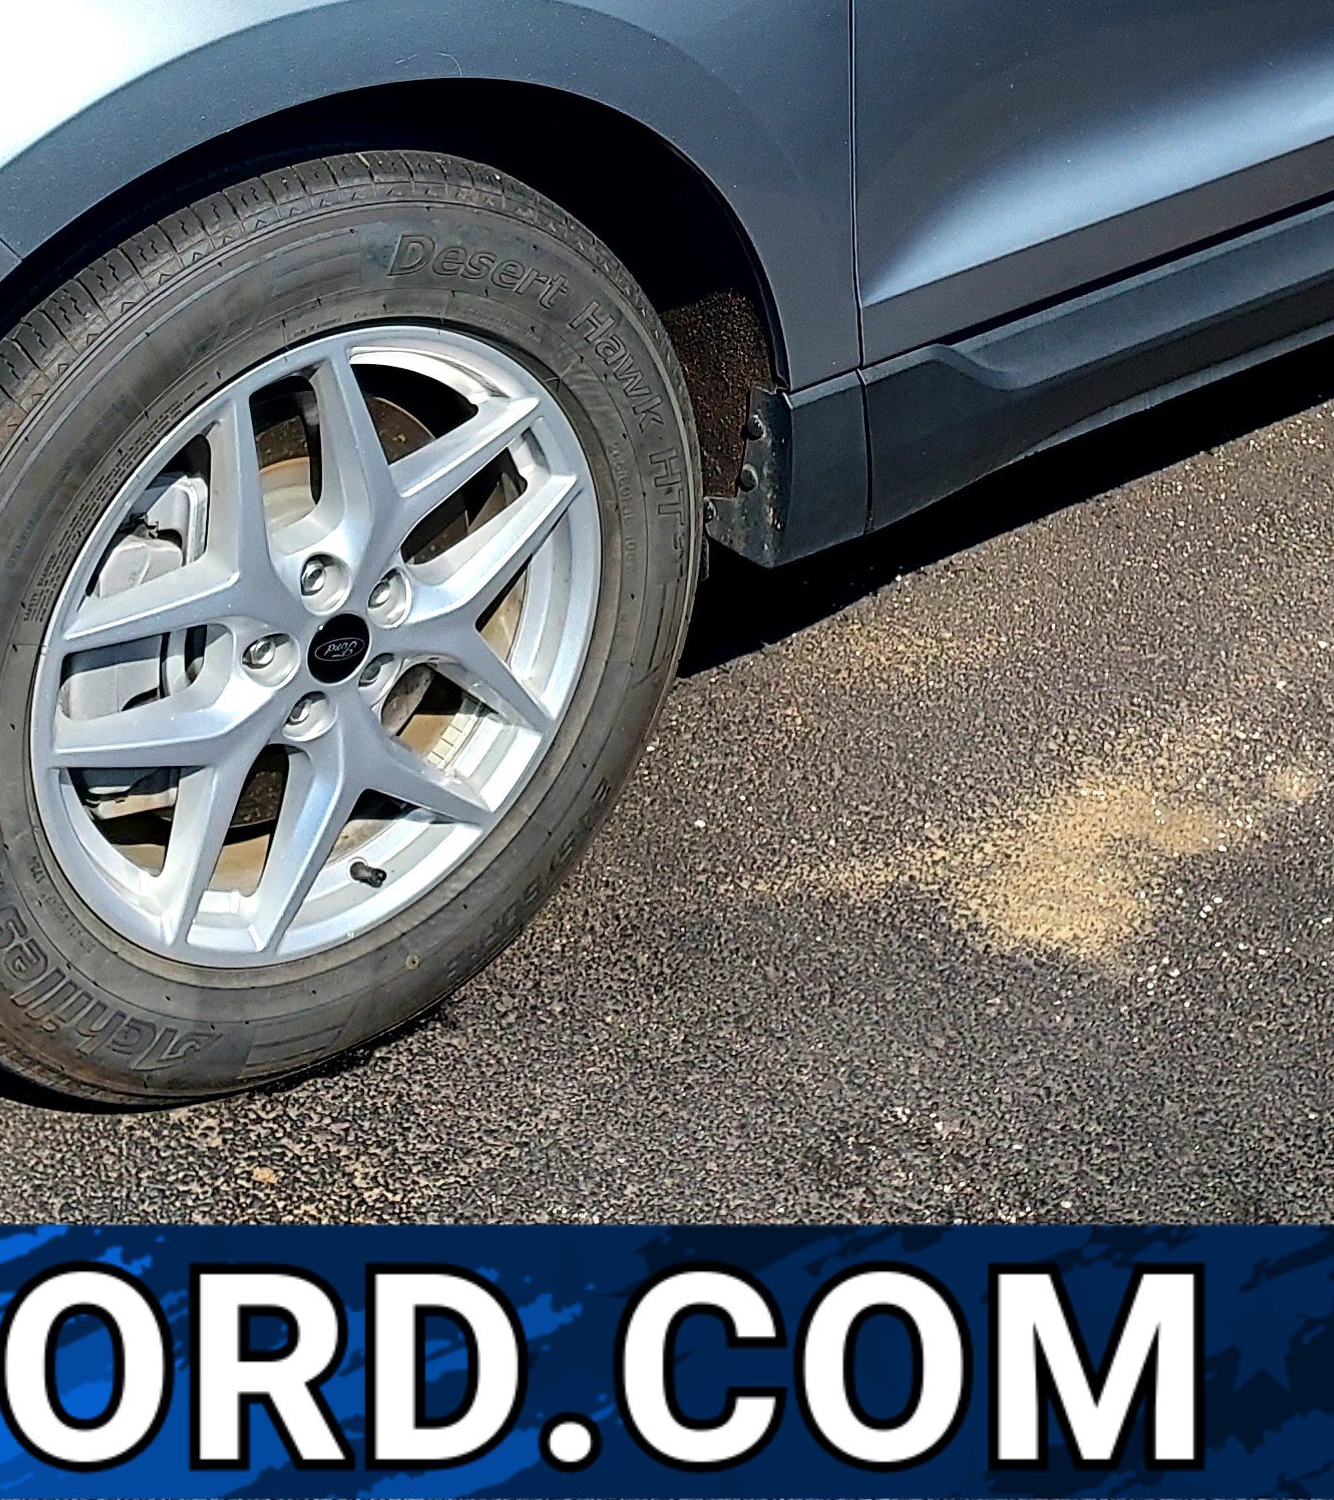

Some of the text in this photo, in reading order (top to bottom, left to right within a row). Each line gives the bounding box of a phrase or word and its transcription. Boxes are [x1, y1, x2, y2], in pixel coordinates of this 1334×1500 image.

[386, 233, 570, 311] Desert
[568, 300, 665, 433] Hawk
[323, 640, 358, 658] Ford
